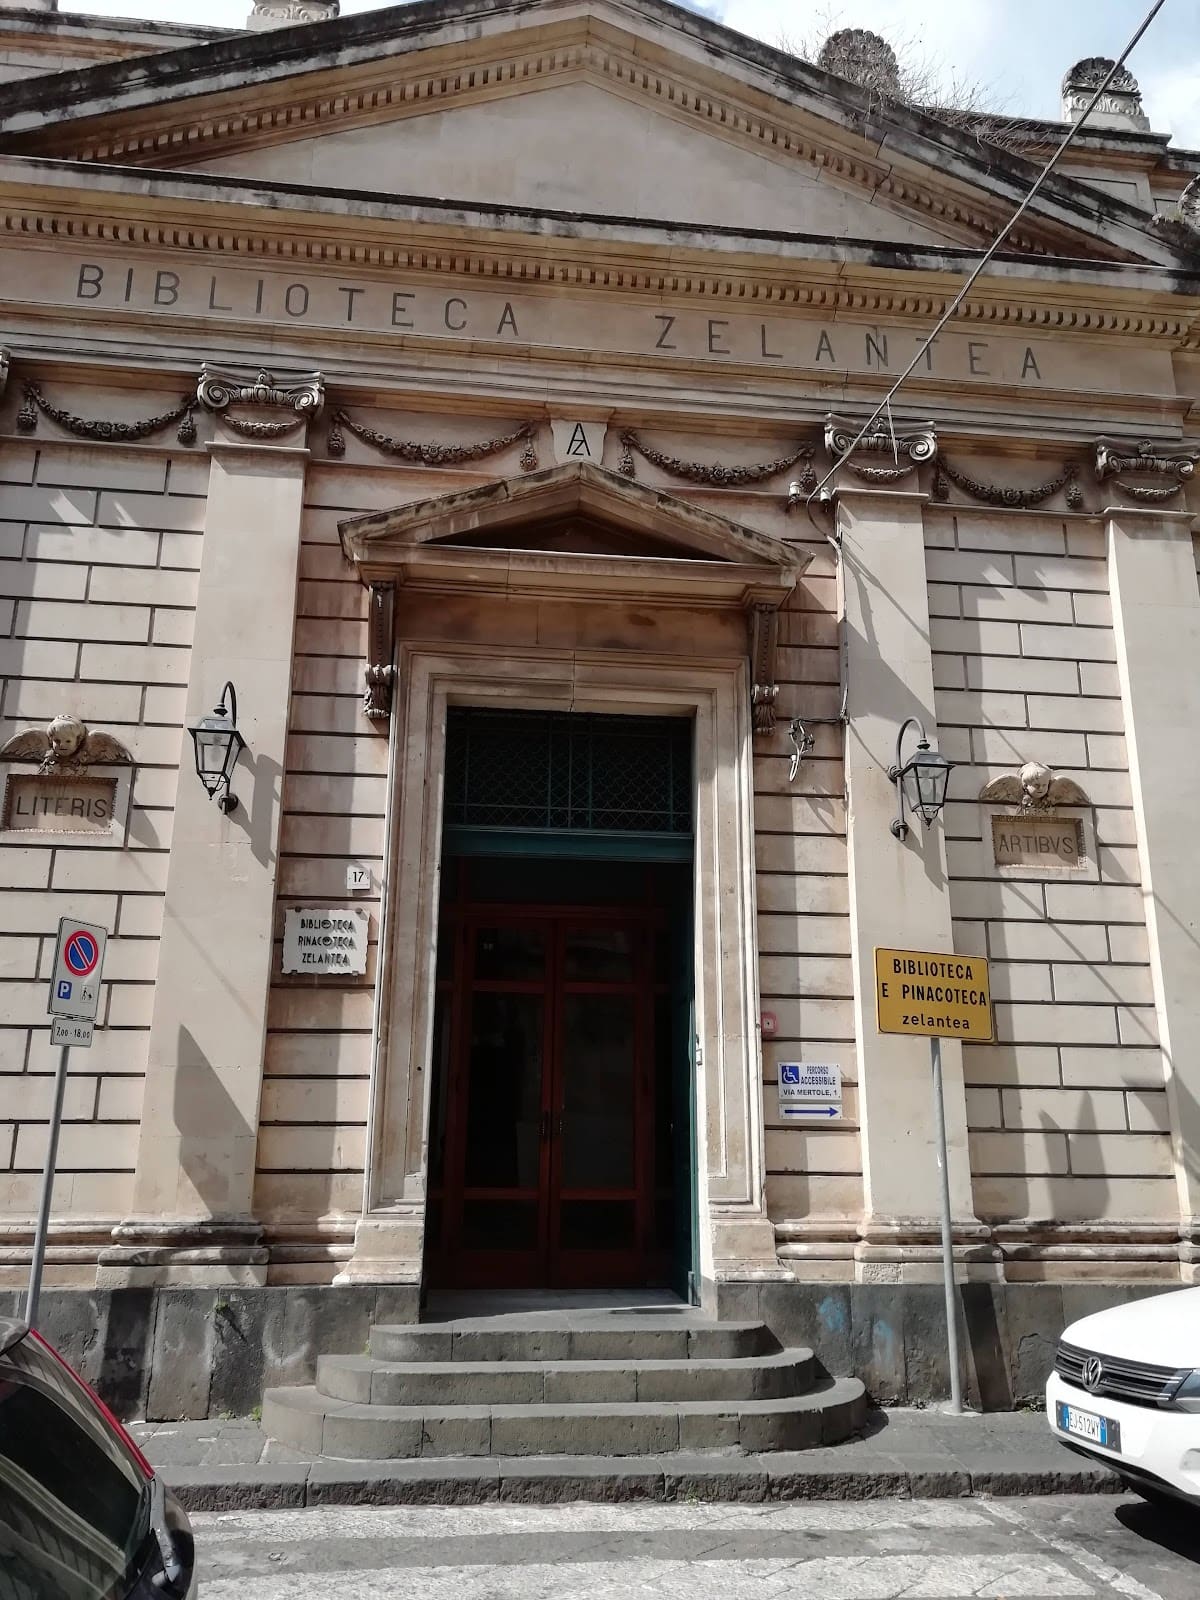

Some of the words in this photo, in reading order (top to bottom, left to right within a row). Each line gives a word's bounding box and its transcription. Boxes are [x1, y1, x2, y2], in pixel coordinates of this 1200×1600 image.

[77, 264, 520, 337] BIBLIOTECA
[654, 314, 1042, 380] ZELANTEA
[16, 795, 107, 818] LITERIS
[999, 834, 1074, 854] ARTIBVS
[352, 871, 365, 883] 17
[300, 918, 354, 930] BIBLIOTECA
[301, 952, 349, 964] ZELANTEA
[893, 958, 973, 980] BIBLIOTECA
[881, 983, 889, 998] E
[902, 984, 987, 1006] PINACOTECA
[902, 1014, 970, 1030] zelantea
[800, 1076, 836, 1086] ACCESSIBILE
